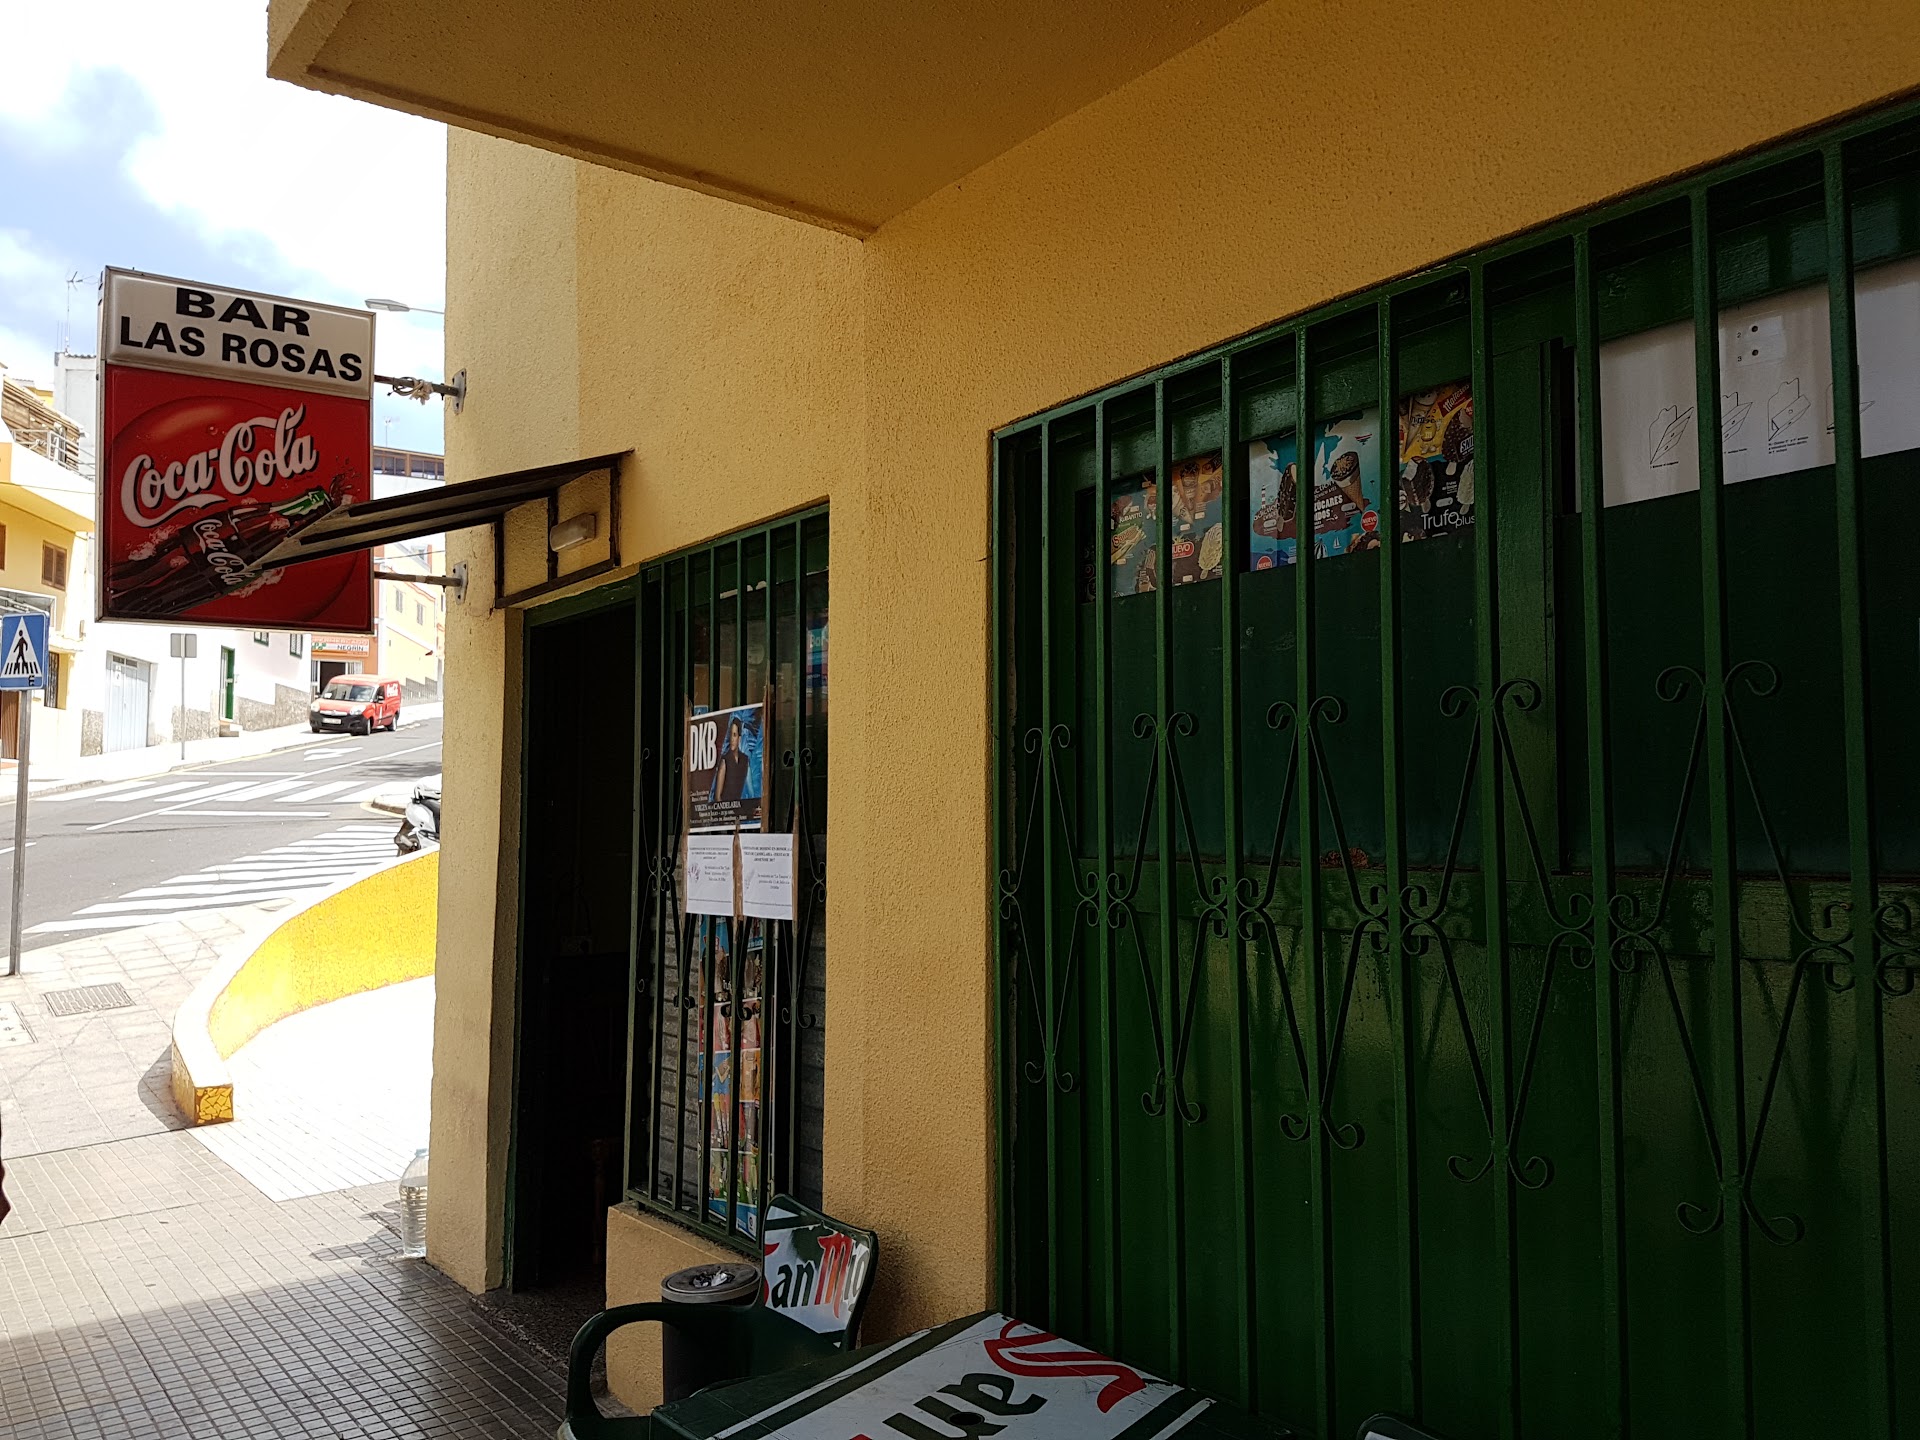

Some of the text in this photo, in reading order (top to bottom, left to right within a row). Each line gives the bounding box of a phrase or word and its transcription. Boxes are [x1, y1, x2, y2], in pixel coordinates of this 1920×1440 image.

[175, 286, 311, 337] BAR
[120, 315, 363, 382] LAS ROSAS
[121, 402, 317, 528] Coca-Cola
[690, 720, 718, 772] DKB
